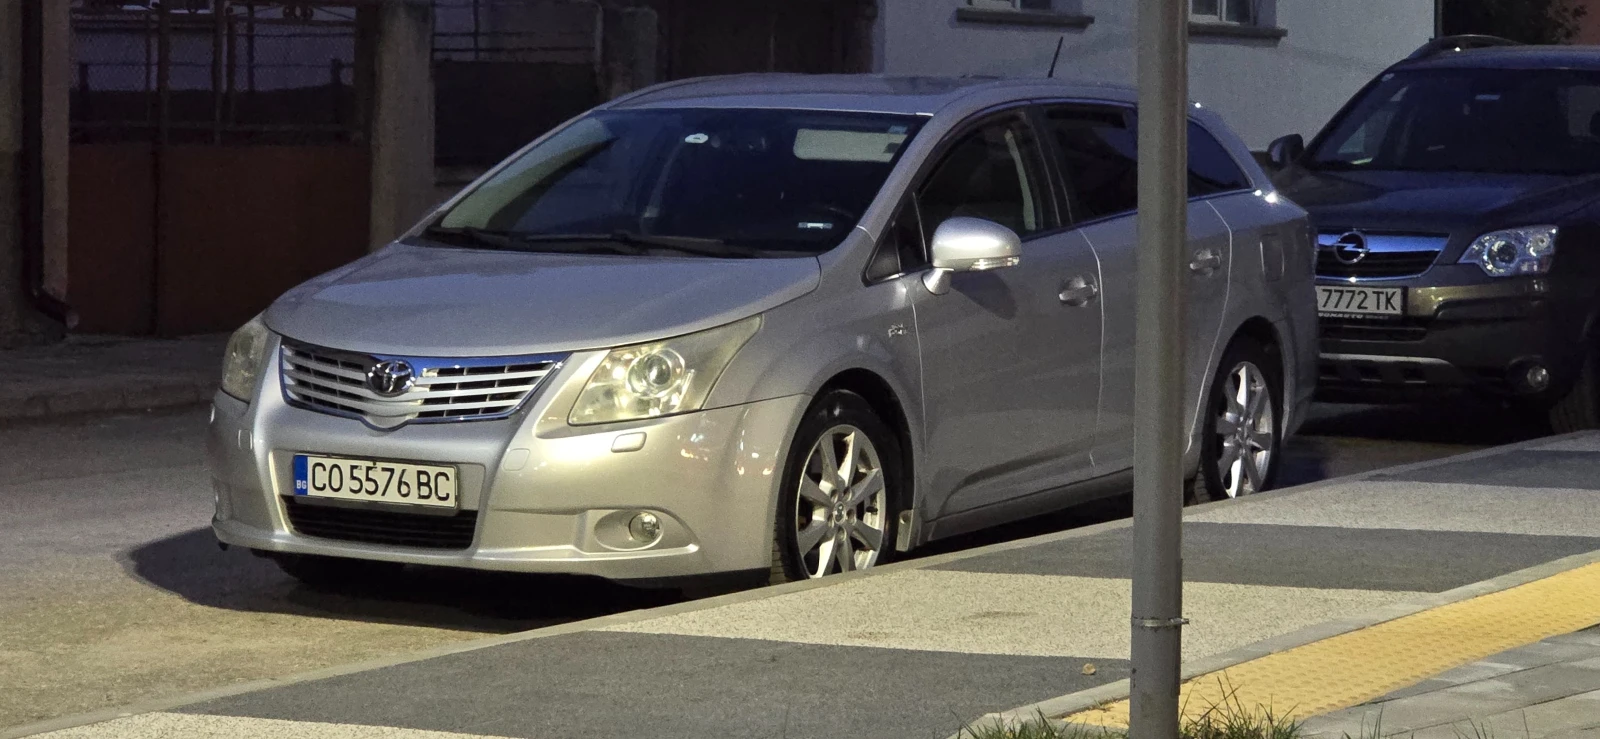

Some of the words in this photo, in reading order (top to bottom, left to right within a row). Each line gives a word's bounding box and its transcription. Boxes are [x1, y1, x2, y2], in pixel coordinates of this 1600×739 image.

[1321, 288, 1368, 310] 7772
[1372, 290, 1397, 311] TK
[296, 479, 307, 490] BG
[312, 462, 343, 493] CO
[349, 465, 411, 498] 5576
[416, 470, 450, 501] BC
